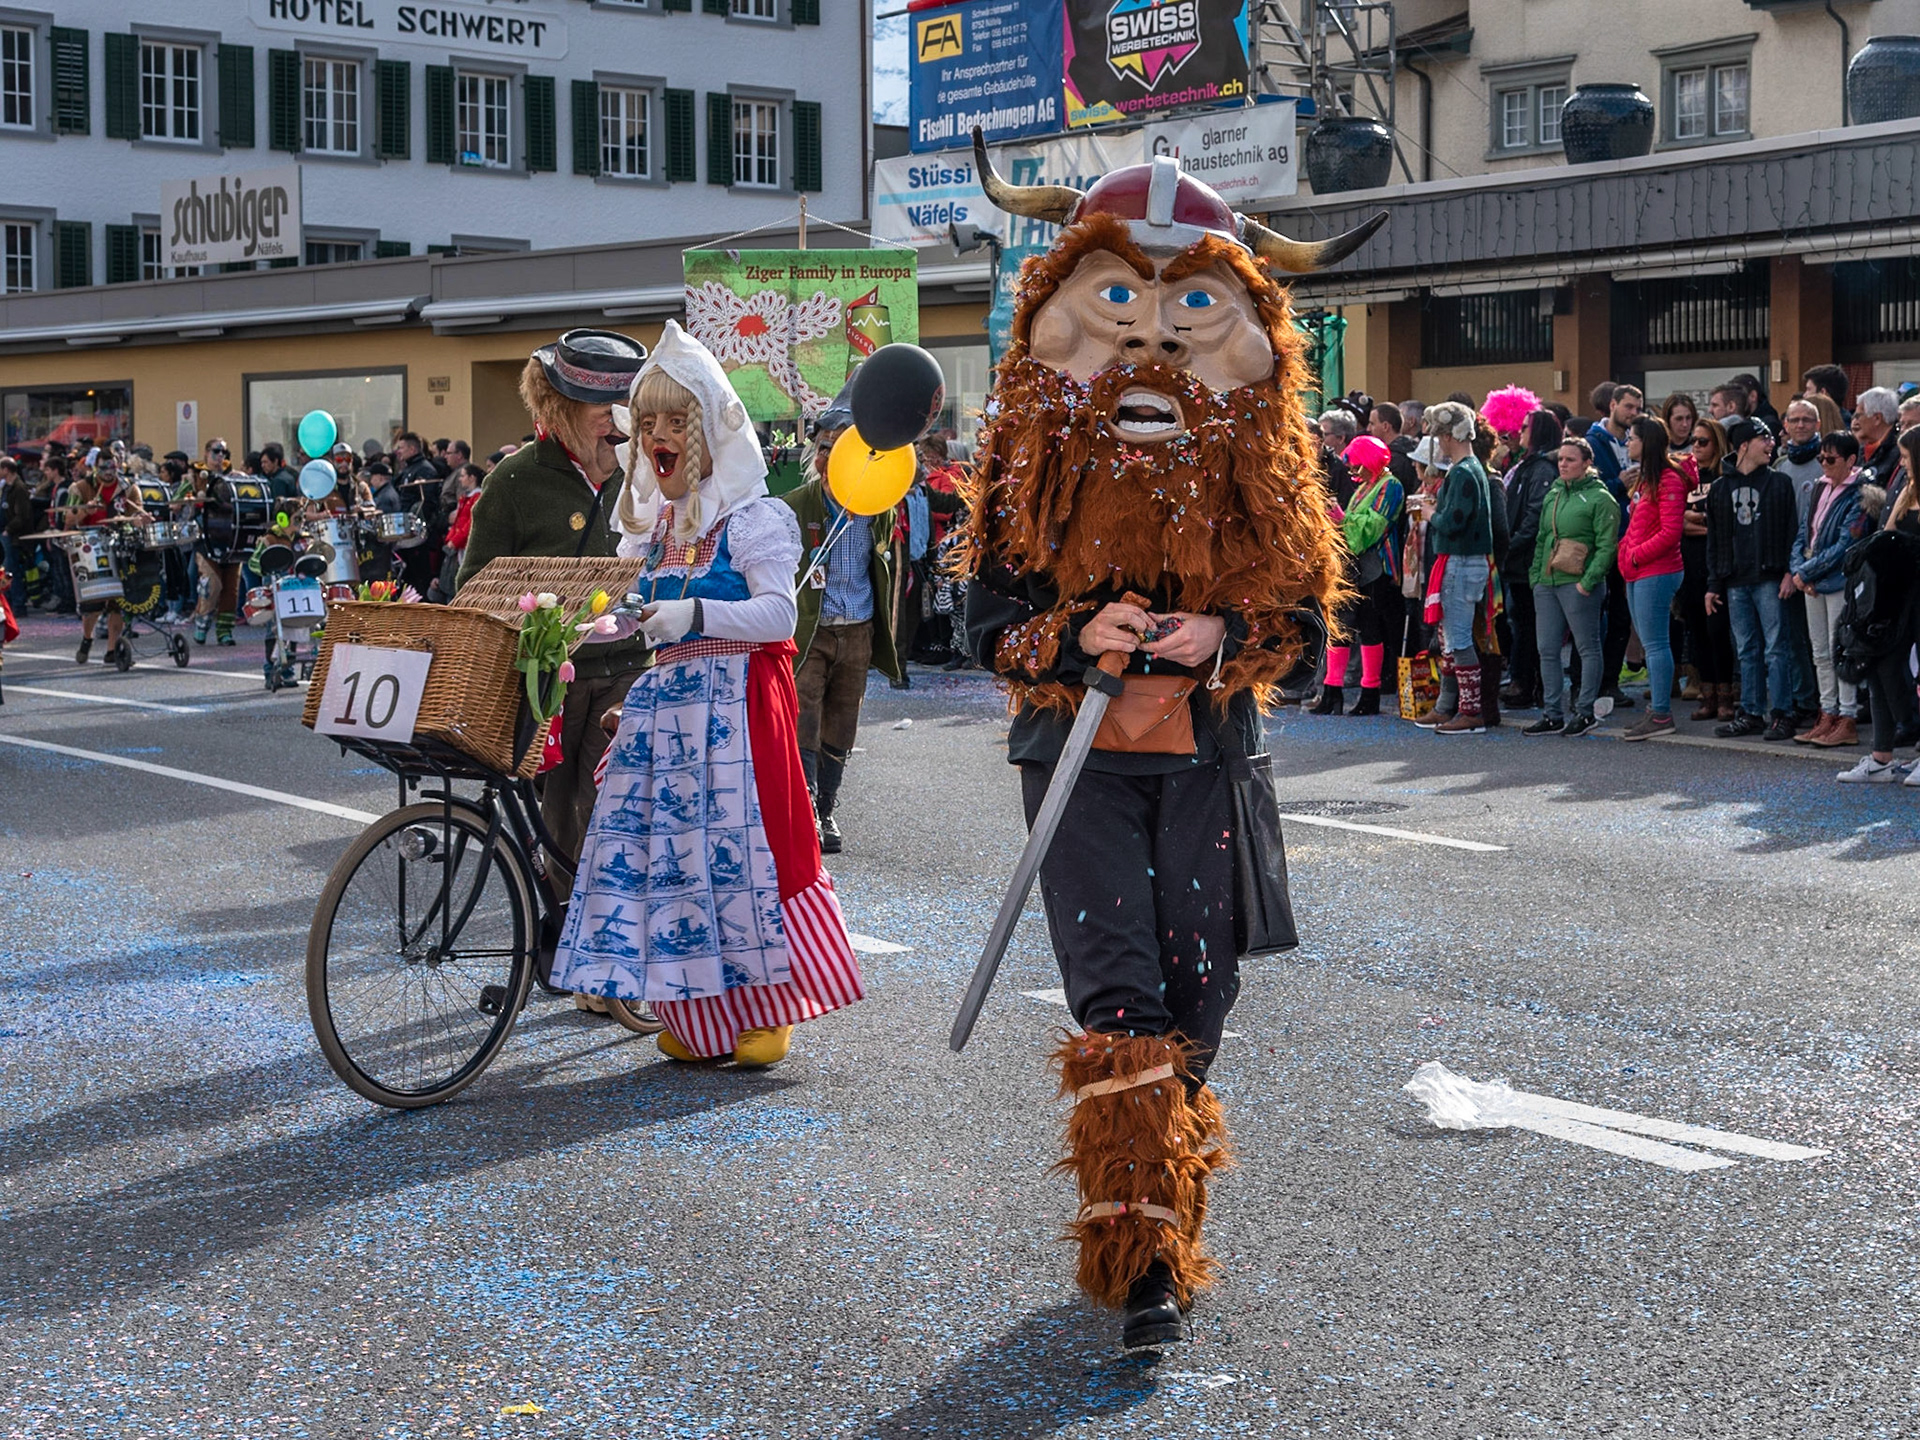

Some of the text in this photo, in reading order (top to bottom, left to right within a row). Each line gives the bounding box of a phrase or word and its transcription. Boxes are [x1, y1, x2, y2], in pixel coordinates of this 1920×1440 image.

[269, 0, 547, 48] HOTEL SCHWERT
[1111, 2, 1195, 42] SWISS
[920, 20, 960, 57] FA
[1111, 29, 1196, 55] WERBETECHNIK
[941, 55, 1028, 82] Ihr Ansprechpartner für
[947, 85, 982, 104] gesamte
[984, 75, 1037, 96] Gebäudehülle
[1070, 78, 1244, 122] swiss-werbetechnik.ch
[919, 97, 1056, 142] Fischli Bedachungen AG
[1202, 126, 1248, 150] glarner
[1183, 145, 1289, 172] haustechnik ag
[908, 162, 972, 189] Stüssi
[171, 176, 289, 257] schubiger
[907, 202, 969, 228] Näfels
[171, 249, 208, 264] Kaufhaus
[257, 241, 284, 256] Näfels
[745, 265, 911, 283] Ziger Family in Europa
[287, 596, 315, 614] 11
[333, 671, 400, 729] 10
